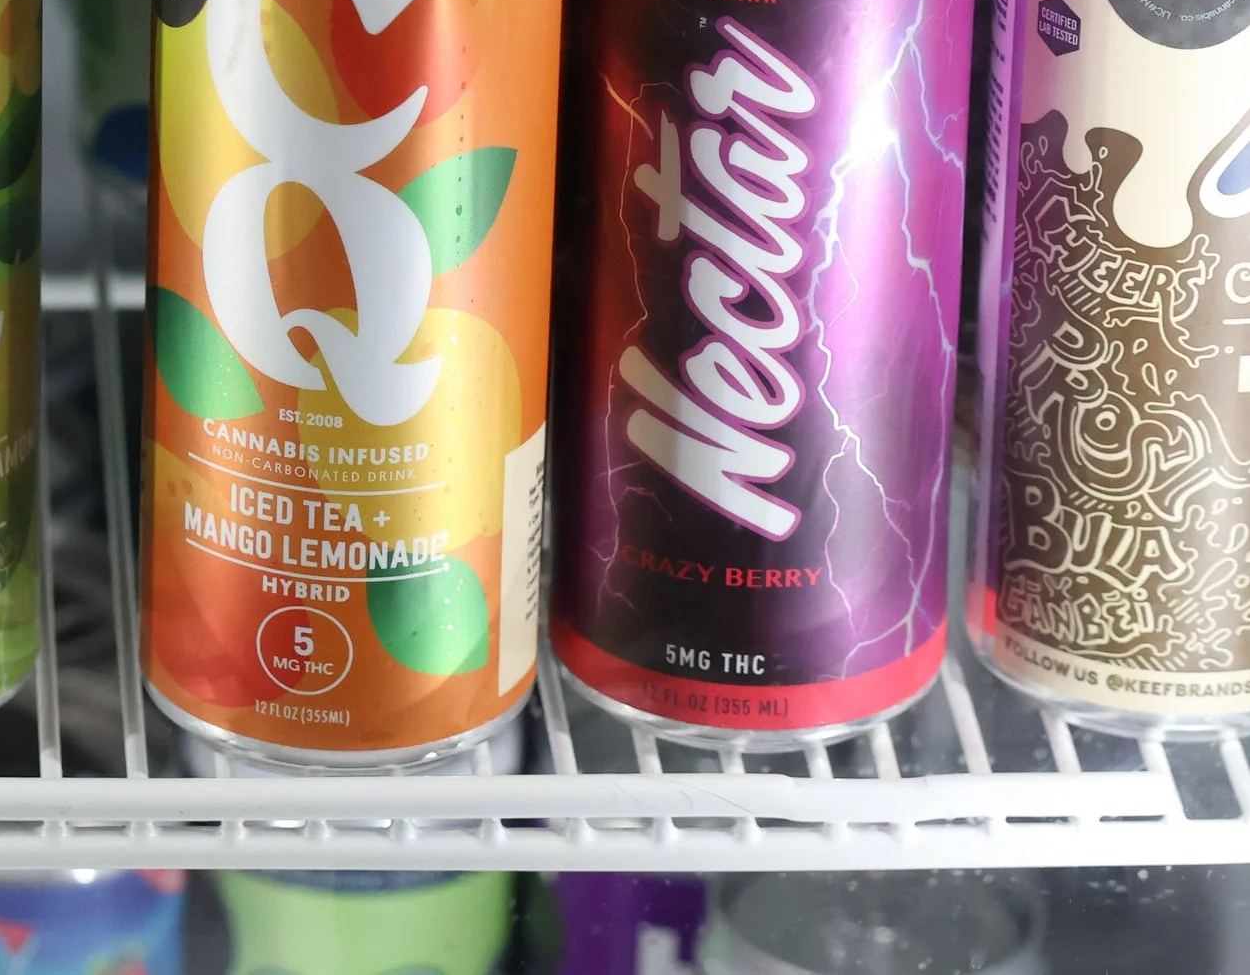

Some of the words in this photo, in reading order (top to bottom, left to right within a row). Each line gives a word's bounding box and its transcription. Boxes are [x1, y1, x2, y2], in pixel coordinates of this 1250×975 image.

[1039, 20, 1051, 35] LAB
[1052, 26, 1078, 45] TESTED
[1041, 7, 1077, 30] CERTIFIED
[617, 17, 820, 540] Nectar
[278, 407, 303, 424] EST.
[306, 412, 343, 429] 2008
[203, 417, 320, 462] CANNABIS
[328, 443, 429, 465] INFUSED
[212, 443, 359, 483] NON-CARBONATED
[368, 468, 415, 482] DRINK
[230, 483, 293, 526] ICED
[303, 499, 363, 532] TEA
[184, 501, 272, 559] MANGO
[282, 531, 449, 570] LEMONADE
[621, 545, 715, 584] CRAZY
[724, 567, 823, 588] BERRY
[262, 575, 350, 603] HYBRID
[293, 626, 314, 656] 5
[273, 656, 300, 673] MG
[303, 659, 334, 676] THC
[665, 644, 711, 671] 5MG
[721, 653, 766, 675] THC
[1004, 637, 1070, 677] FOLLOW
[1074, 666, 1098, 686] US
[255, 700, 267, 715] 12
[269, 702, 282, 717] FL
[283, 704, 299, 720] OZ
[300, 706, 350, 727] (355ML)
[664, 689, 680, 707] FL
[688, 693, 707, 711] OZ
